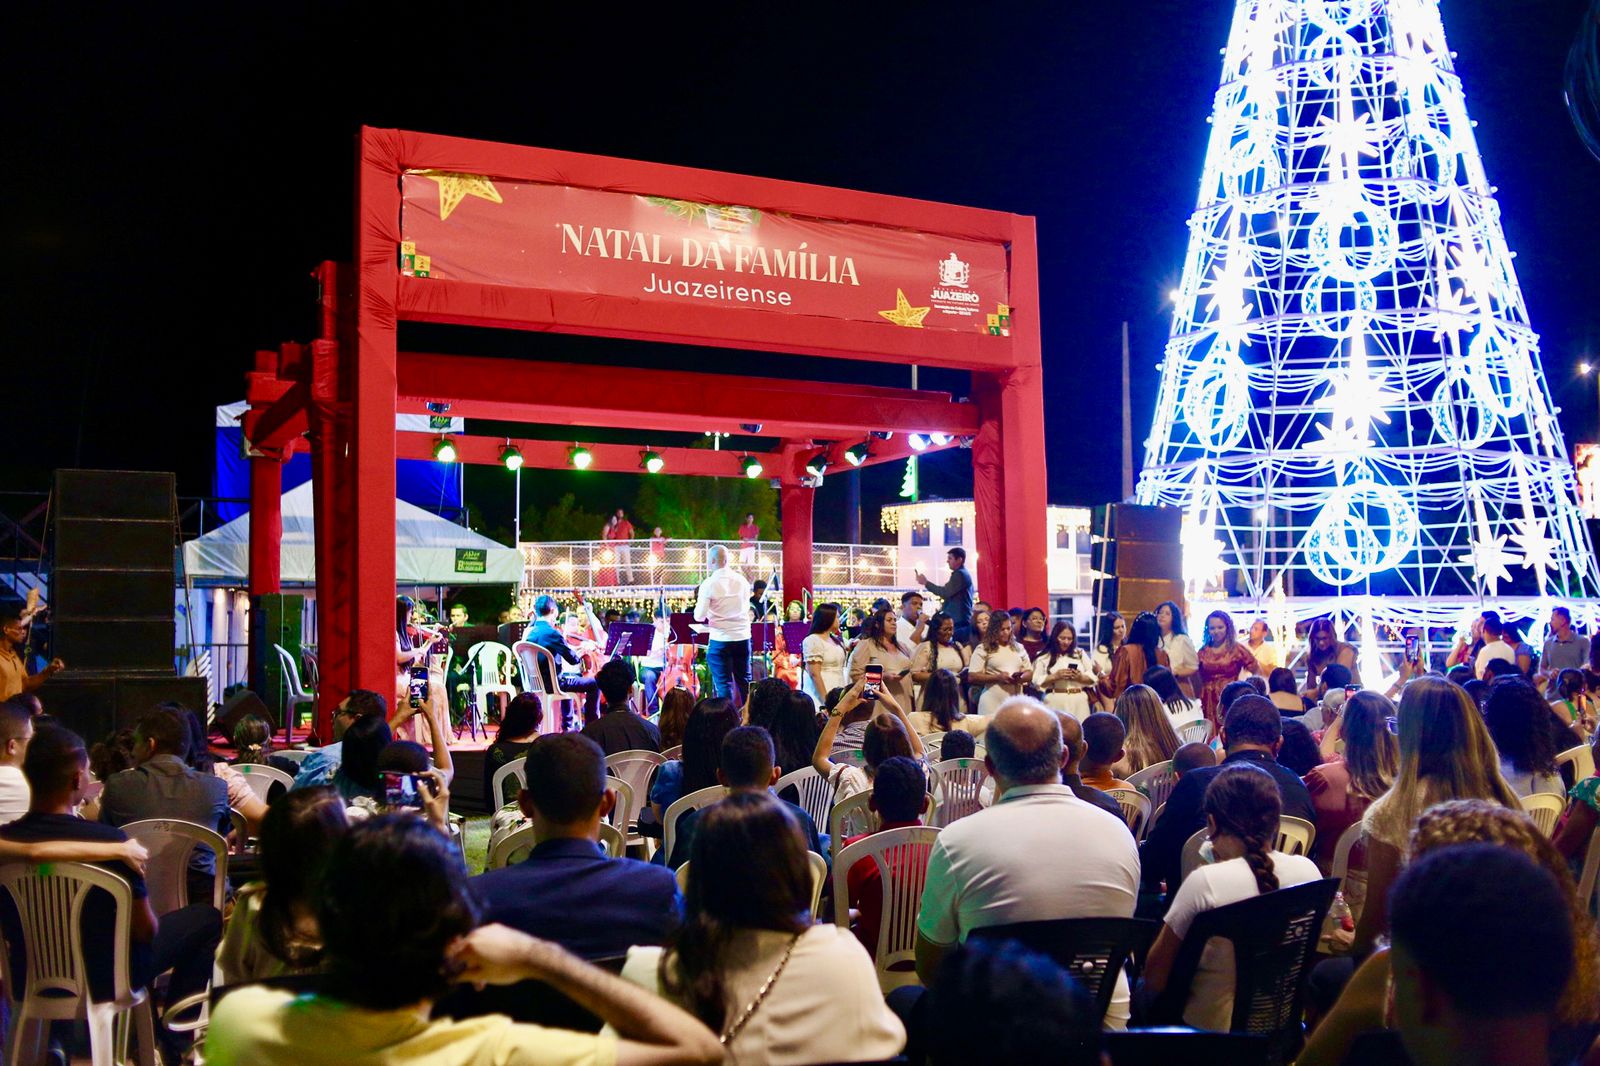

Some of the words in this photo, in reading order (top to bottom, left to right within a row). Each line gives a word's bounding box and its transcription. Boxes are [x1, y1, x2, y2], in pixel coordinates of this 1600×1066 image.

[561, 223, 673, 265] NATAL
[681, 237, 725, 271] DA
[735, 241, 861, 286] FAMÍLIA
[643, 272, 792, 306] Juazeirense
[930, 289, 980, 303] JUAZEIRO
